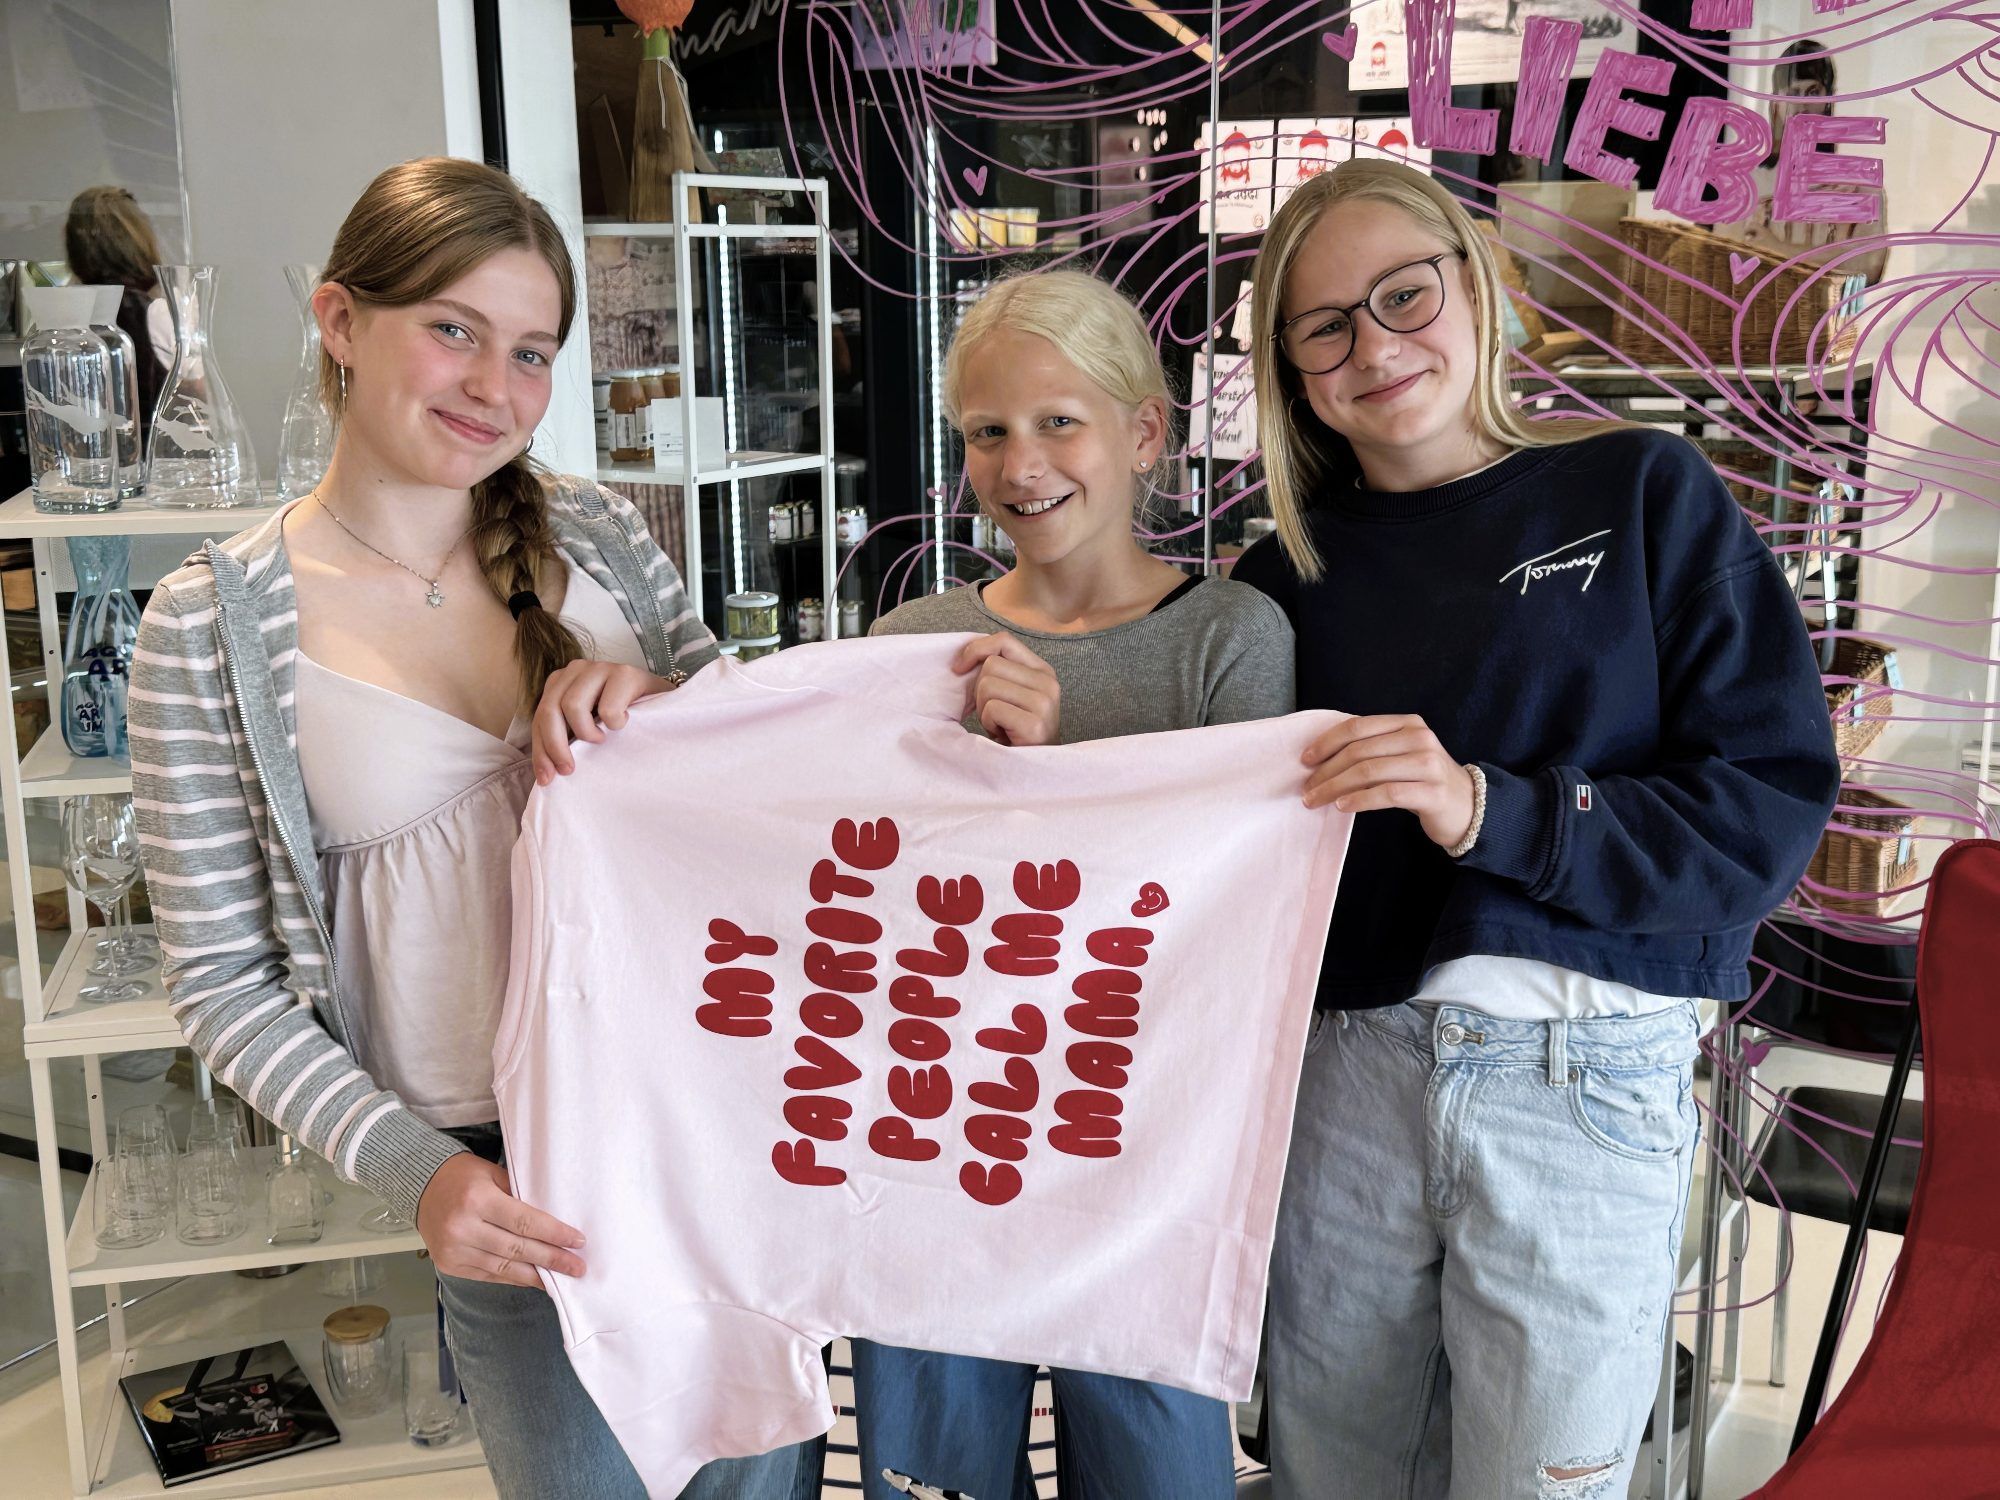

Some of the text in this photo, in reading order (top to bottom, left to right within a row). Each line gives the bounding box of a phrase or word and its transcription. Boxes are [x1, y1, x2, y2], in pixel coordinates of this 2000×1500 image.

[1406, 0, 1888, 224] LIEBE
[1499, 529, 1613, 595] Tommy
[696, 918, 779, 1038] MY
[771, 817, 900, 1186] FAVORITE
[868, 874, 984, 1162] PEOPLE
[959, 859, 1081, 1206] CALL ME
[1047, 927, 1154, 1158] MAMA
